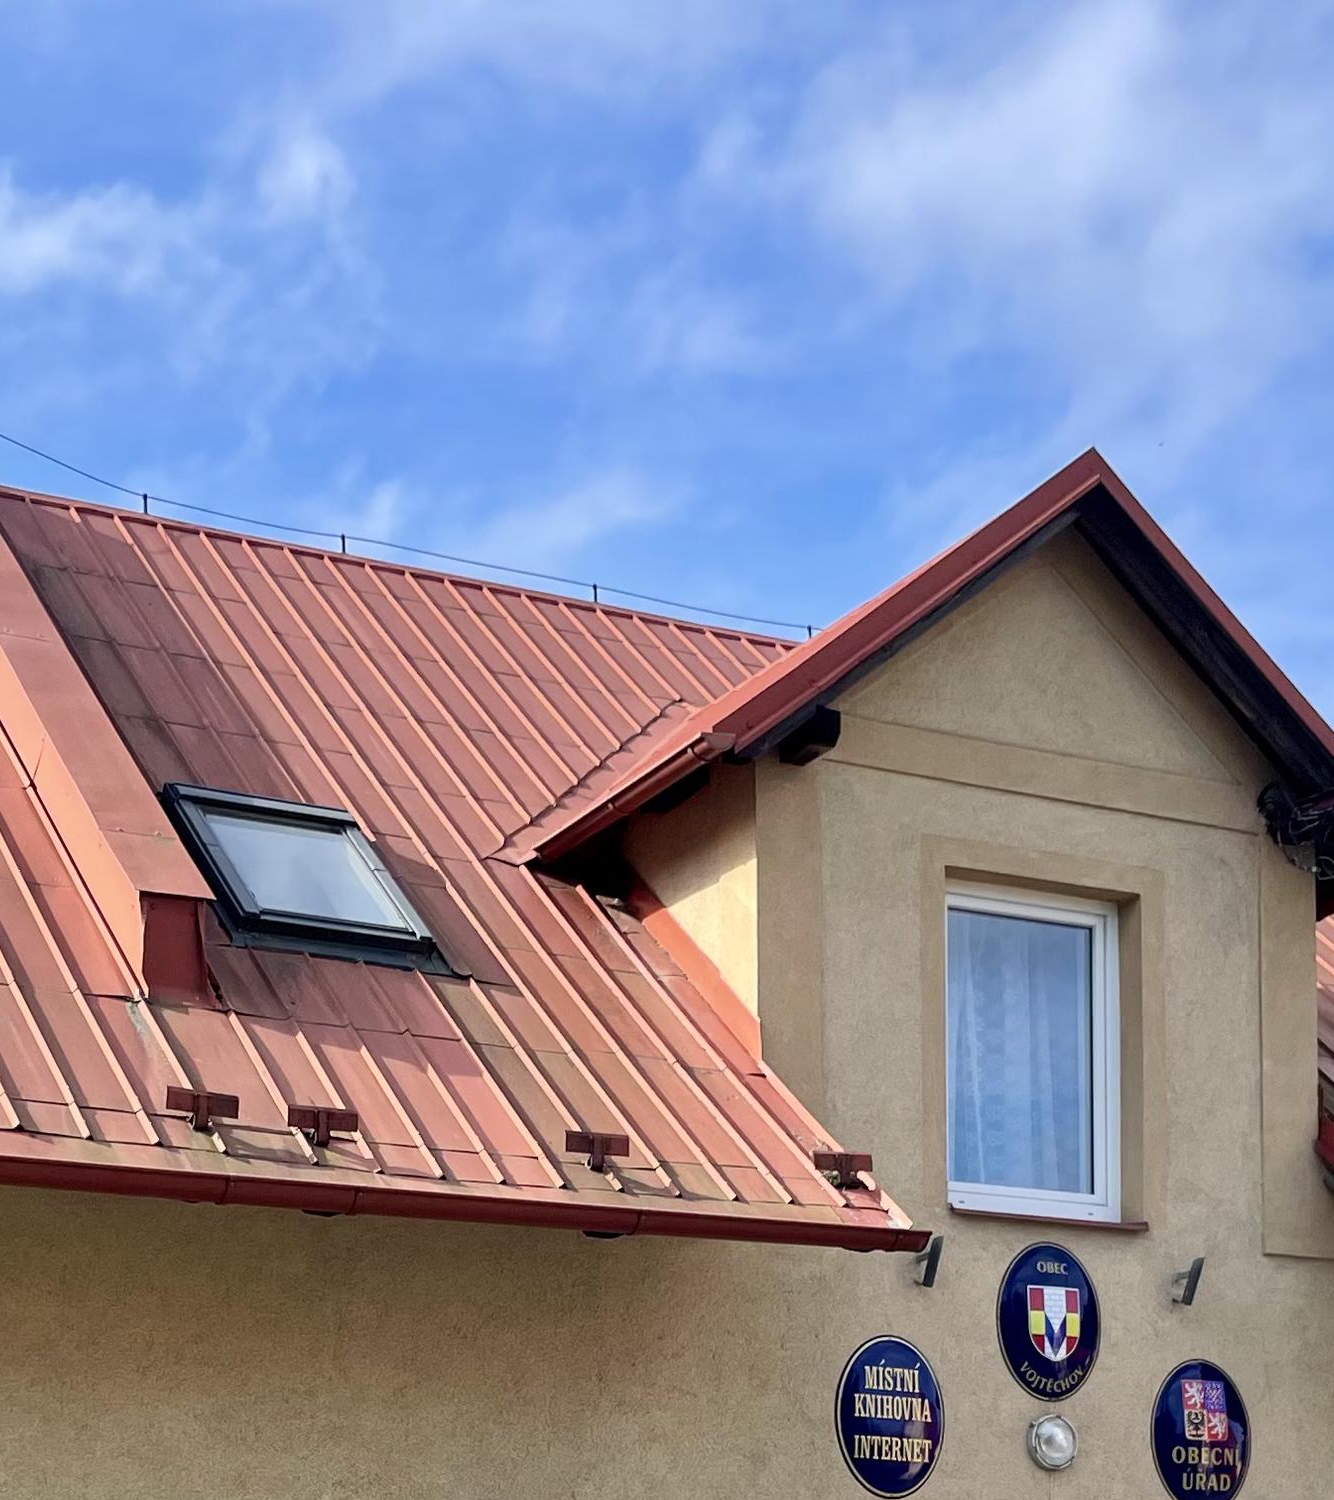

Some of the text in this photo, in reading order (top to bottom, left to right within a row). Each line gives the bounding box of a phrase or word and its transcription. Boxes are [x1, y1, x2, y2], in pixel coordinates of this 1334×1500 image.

[1036, 1260, 1068, 1275] OBEC
[864, 1359, 920, 1393] MÍSTNÍ
[853, 1393, 932, 1422] KNIHOVNA
[853, 1434, 932, 1463] INTERNET
[1182, 1467, 1232, 1491] ÚŘAD
